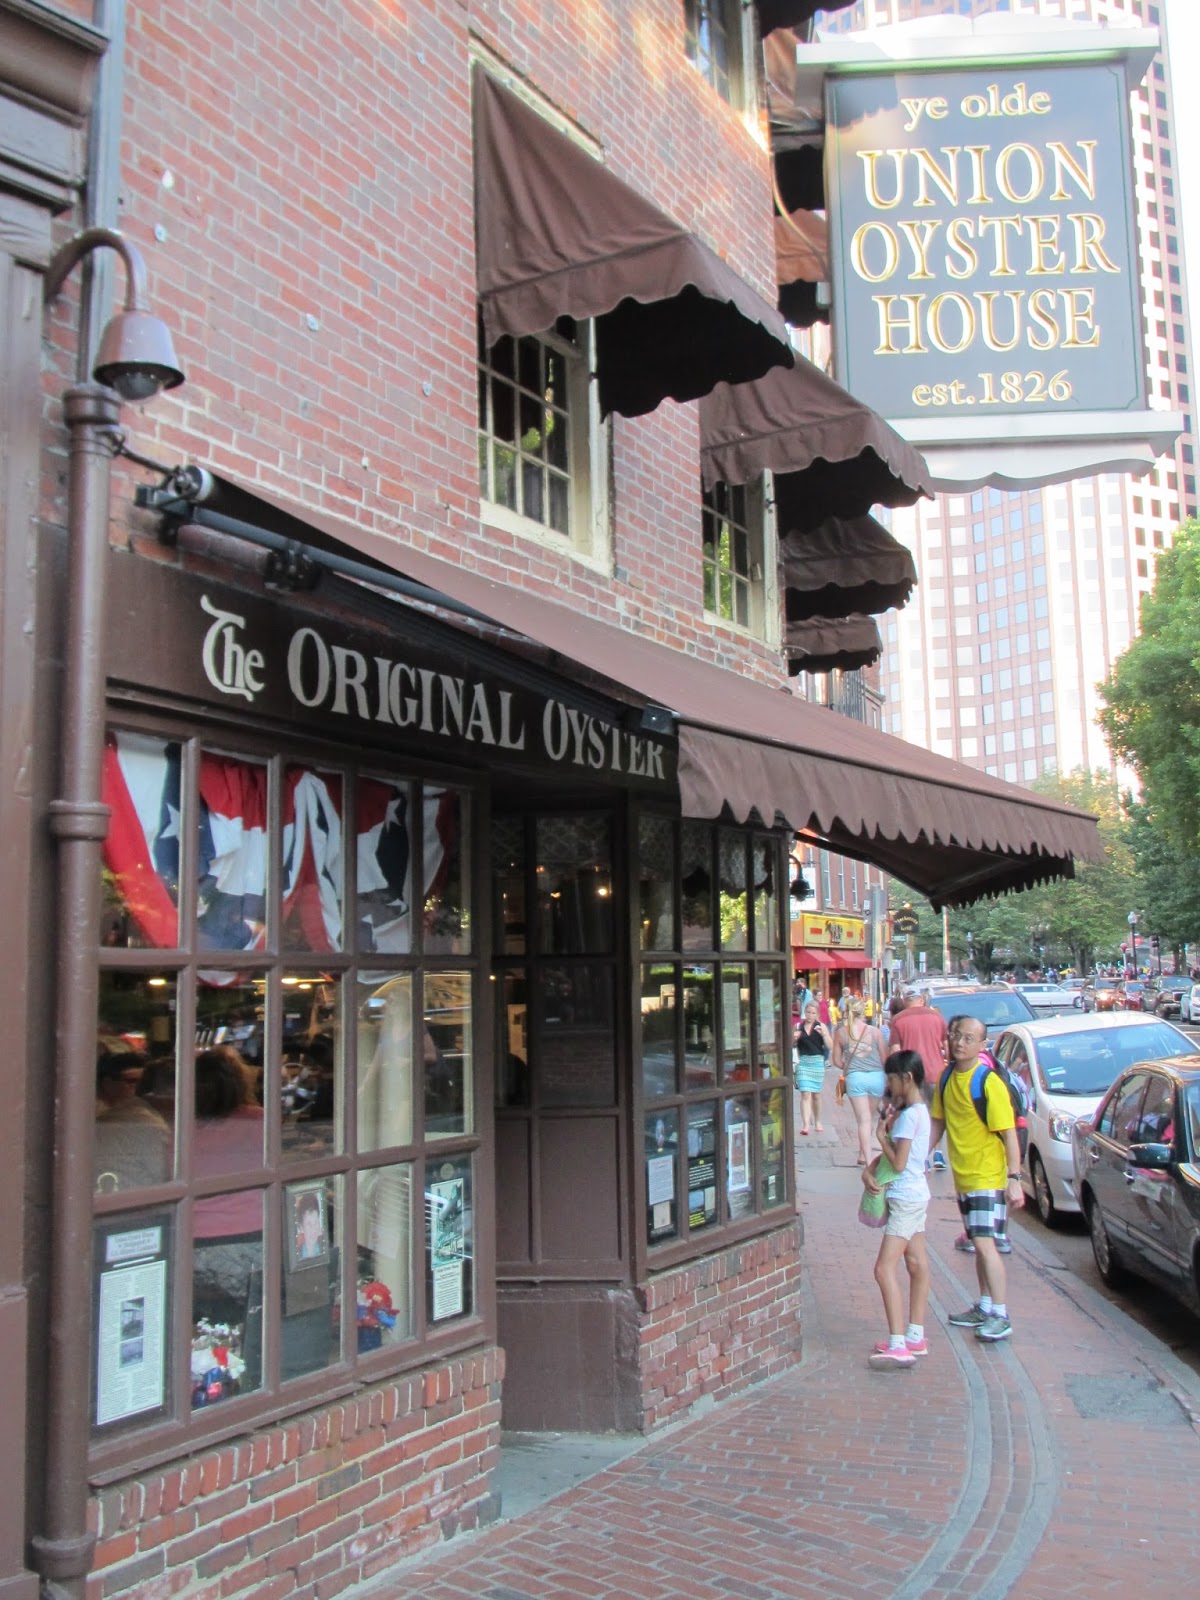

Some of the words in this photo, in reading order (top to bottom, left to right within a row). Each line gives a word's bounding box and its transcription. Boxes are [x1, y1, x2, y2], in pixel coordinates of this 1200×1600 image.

[901, 93, 949, 131] ye
[960, 82, 1052, 119] olde
[856, 140, 1098, 210] UNION
[850, 212, 1121, 283] OYSTER
[871, 287, 1100, 355] HOUSE
[200, 594, 266, 702] The
[286, 626, 526, 752] ORIGINAL
[542, 698, 665, 780] OYSTER
